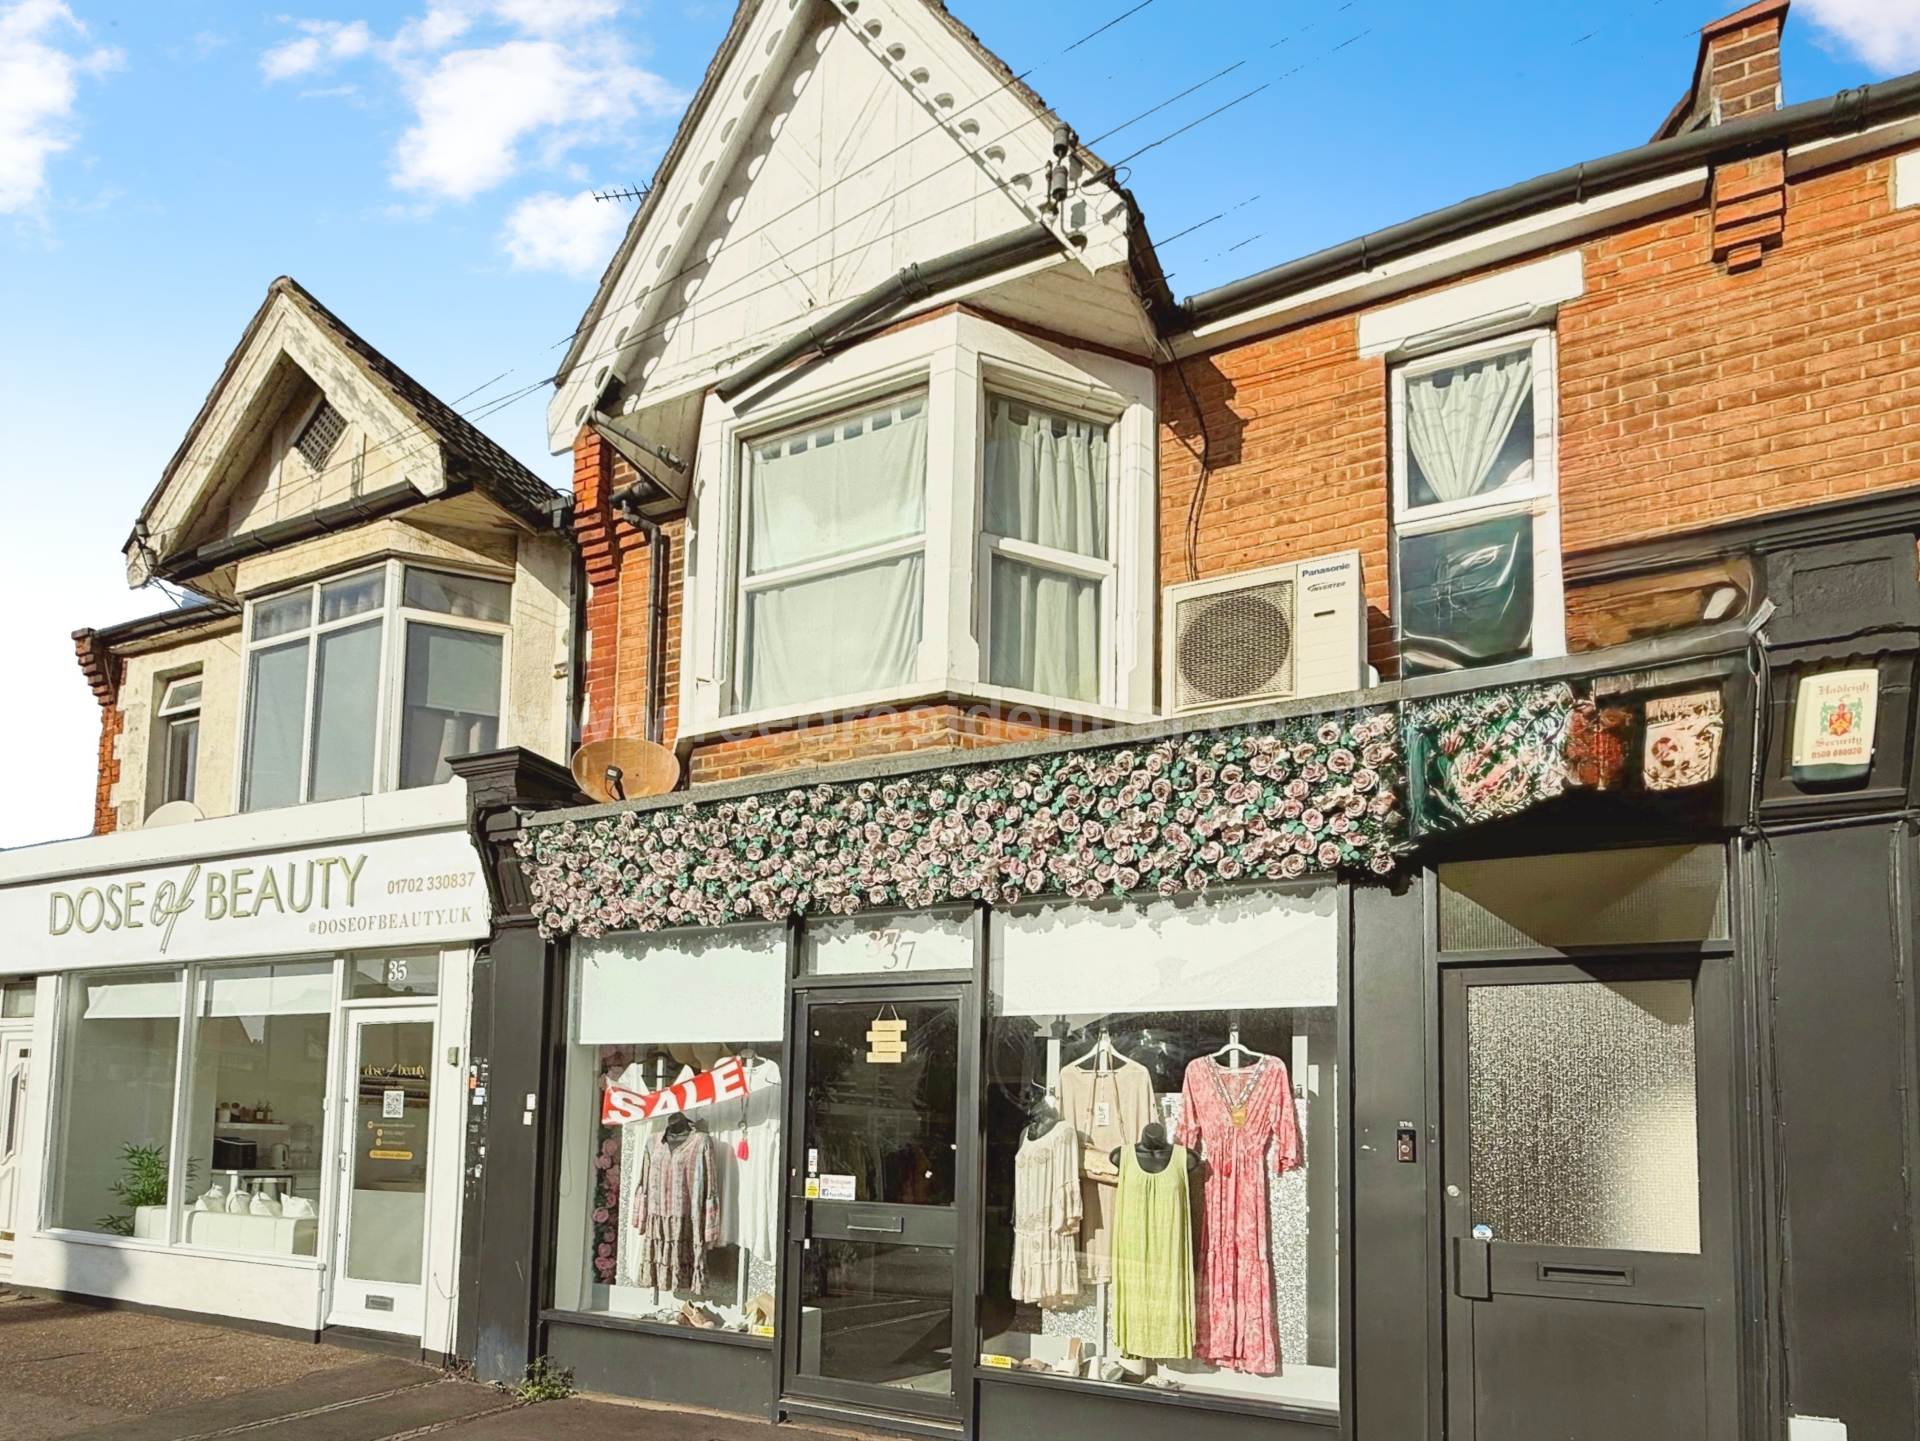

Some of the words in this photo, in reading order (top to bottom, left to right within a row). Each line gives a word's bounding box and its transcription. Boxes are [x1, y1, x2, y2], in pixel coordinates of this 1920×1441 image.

[1302, 563, 1350, 577] Panasonic
[387, 877, 424, 894] 01702
[427, 872, 476, 890] 330837
[49, 881, 146, 935] DOSE
[205, 854, 368, 920] BEAUTY
[388, 960, 407, 981] 35
[602, 1060, 745, 1125] SALE
